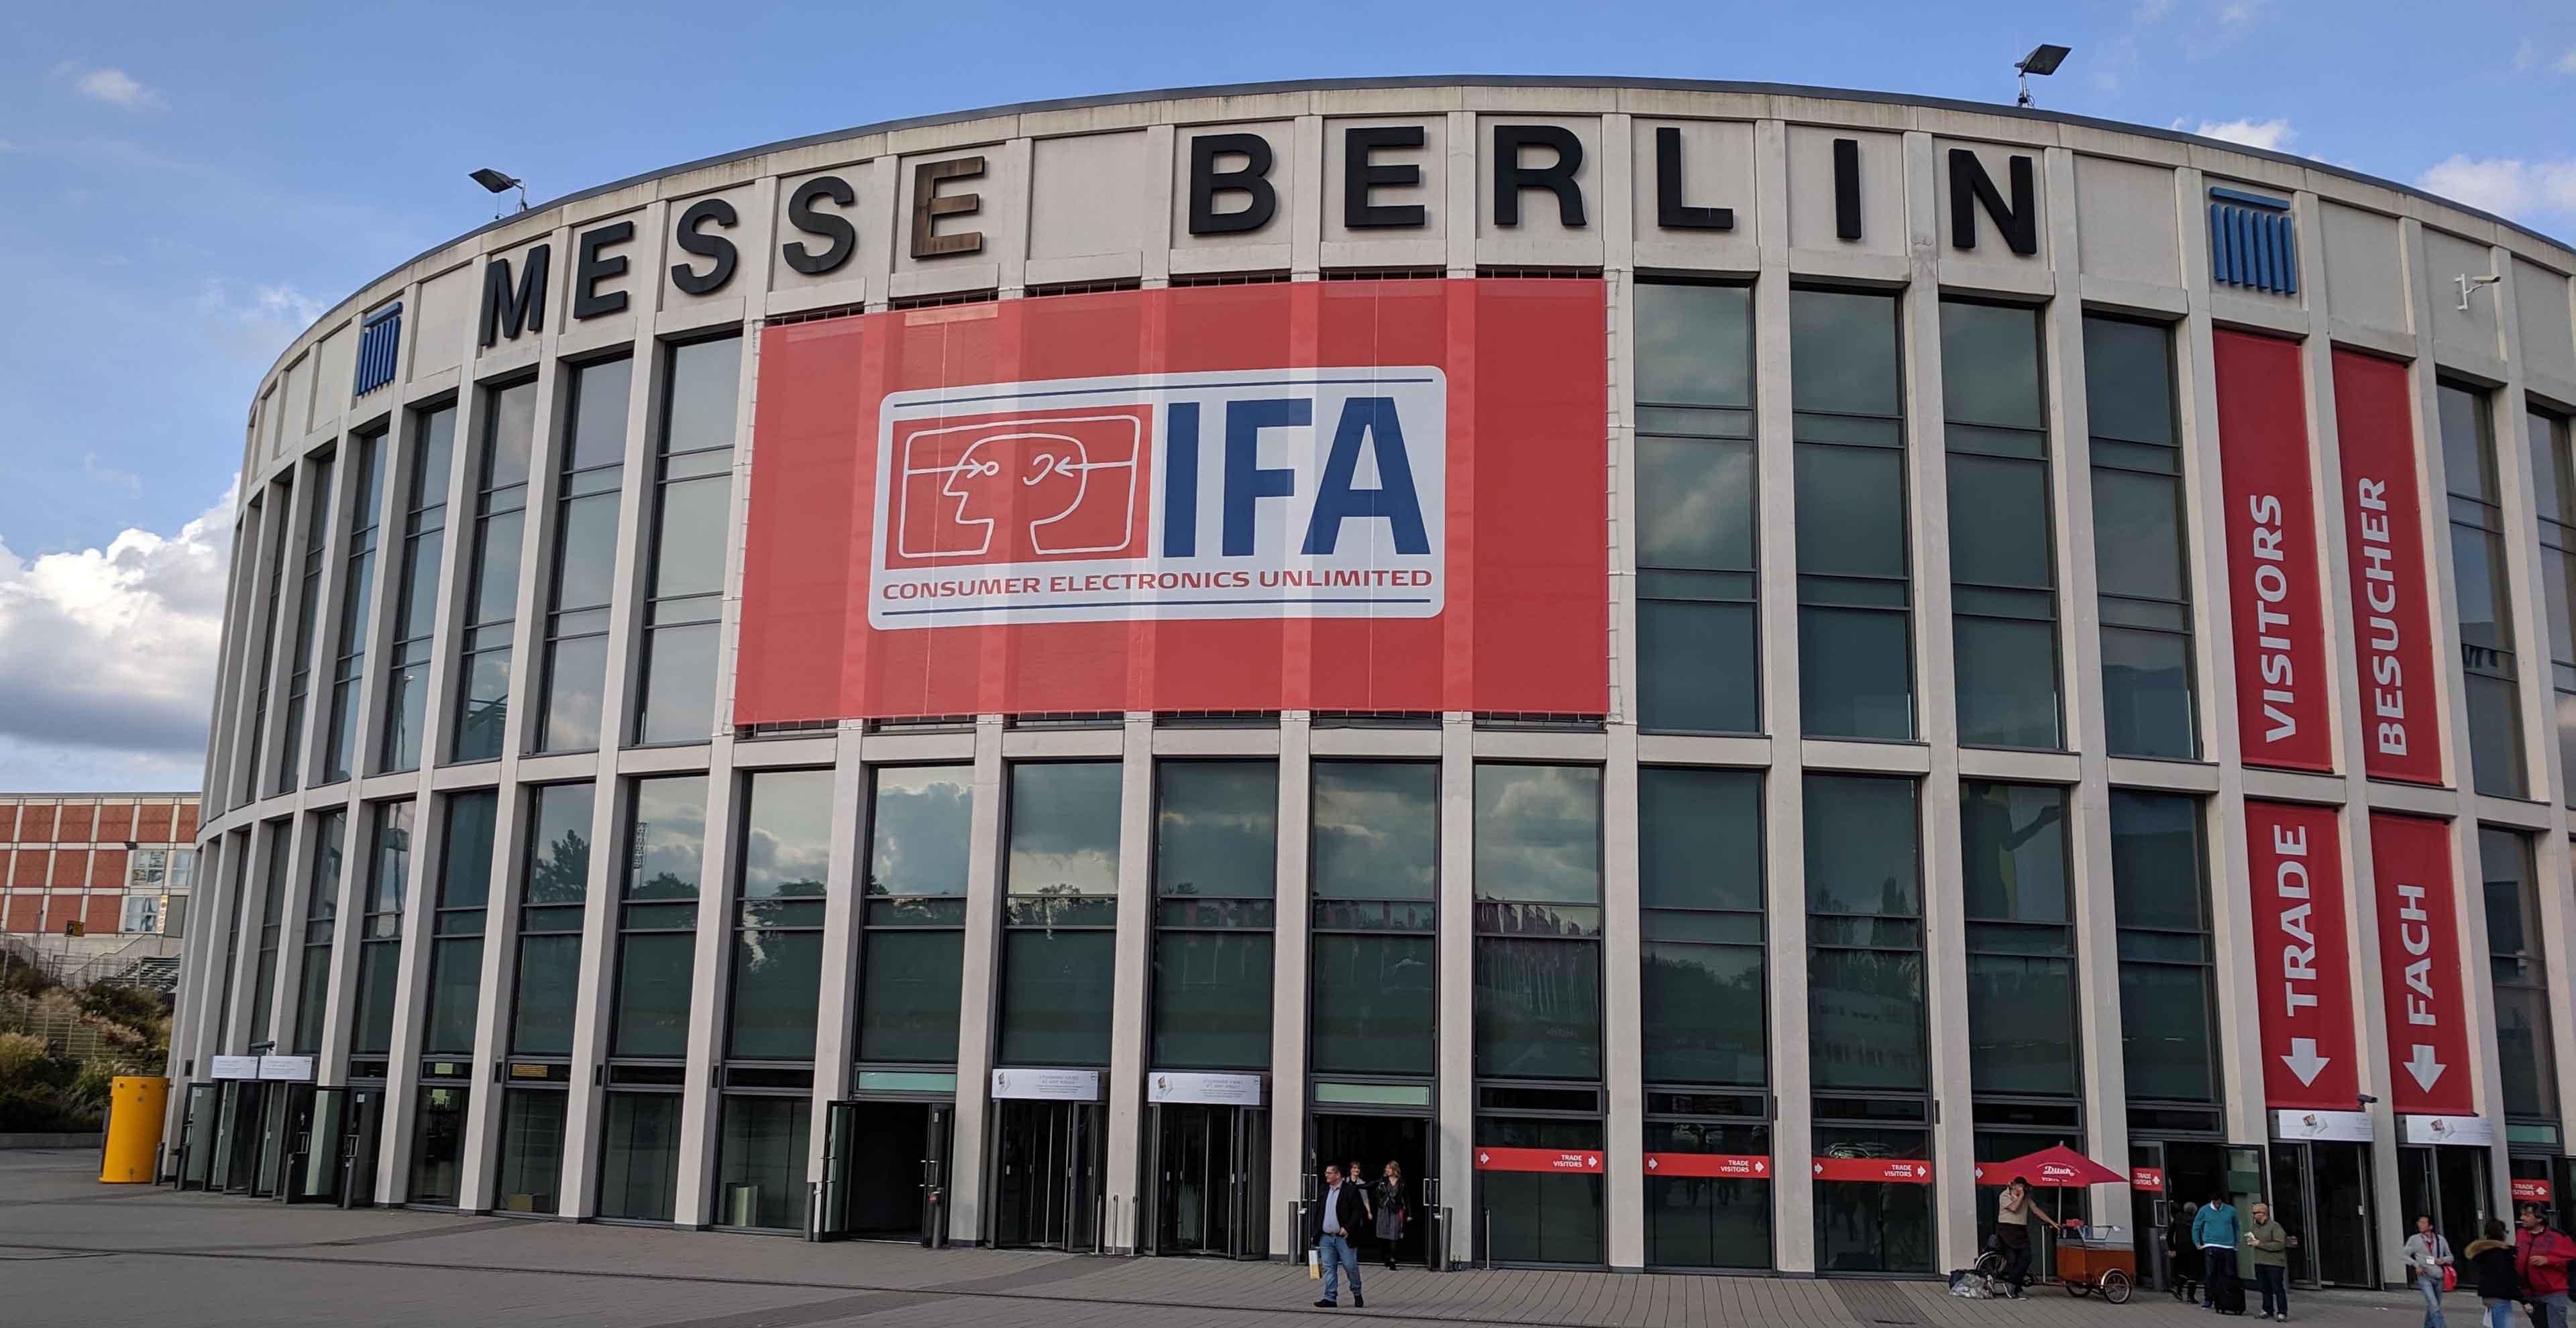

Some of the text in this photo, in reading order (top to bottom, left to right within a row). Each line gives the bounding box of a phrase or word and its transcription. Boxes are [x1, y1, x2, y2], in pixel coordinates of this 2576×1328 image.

[480, 124, 2037, 347] MESSE BERLIN
[1163, 396, 1432, 559] IFA
[882, 568, 1434, 600] CONSUMER ELECTRONICS UNLIMITED
[2249, 494, 2297, 743] VISITORS
[2358, 477, 2408, 757] BESUCHER
[2273, 824, 2318, 1017] TRADE
[2397, 884, 2437, 1026] FACH
